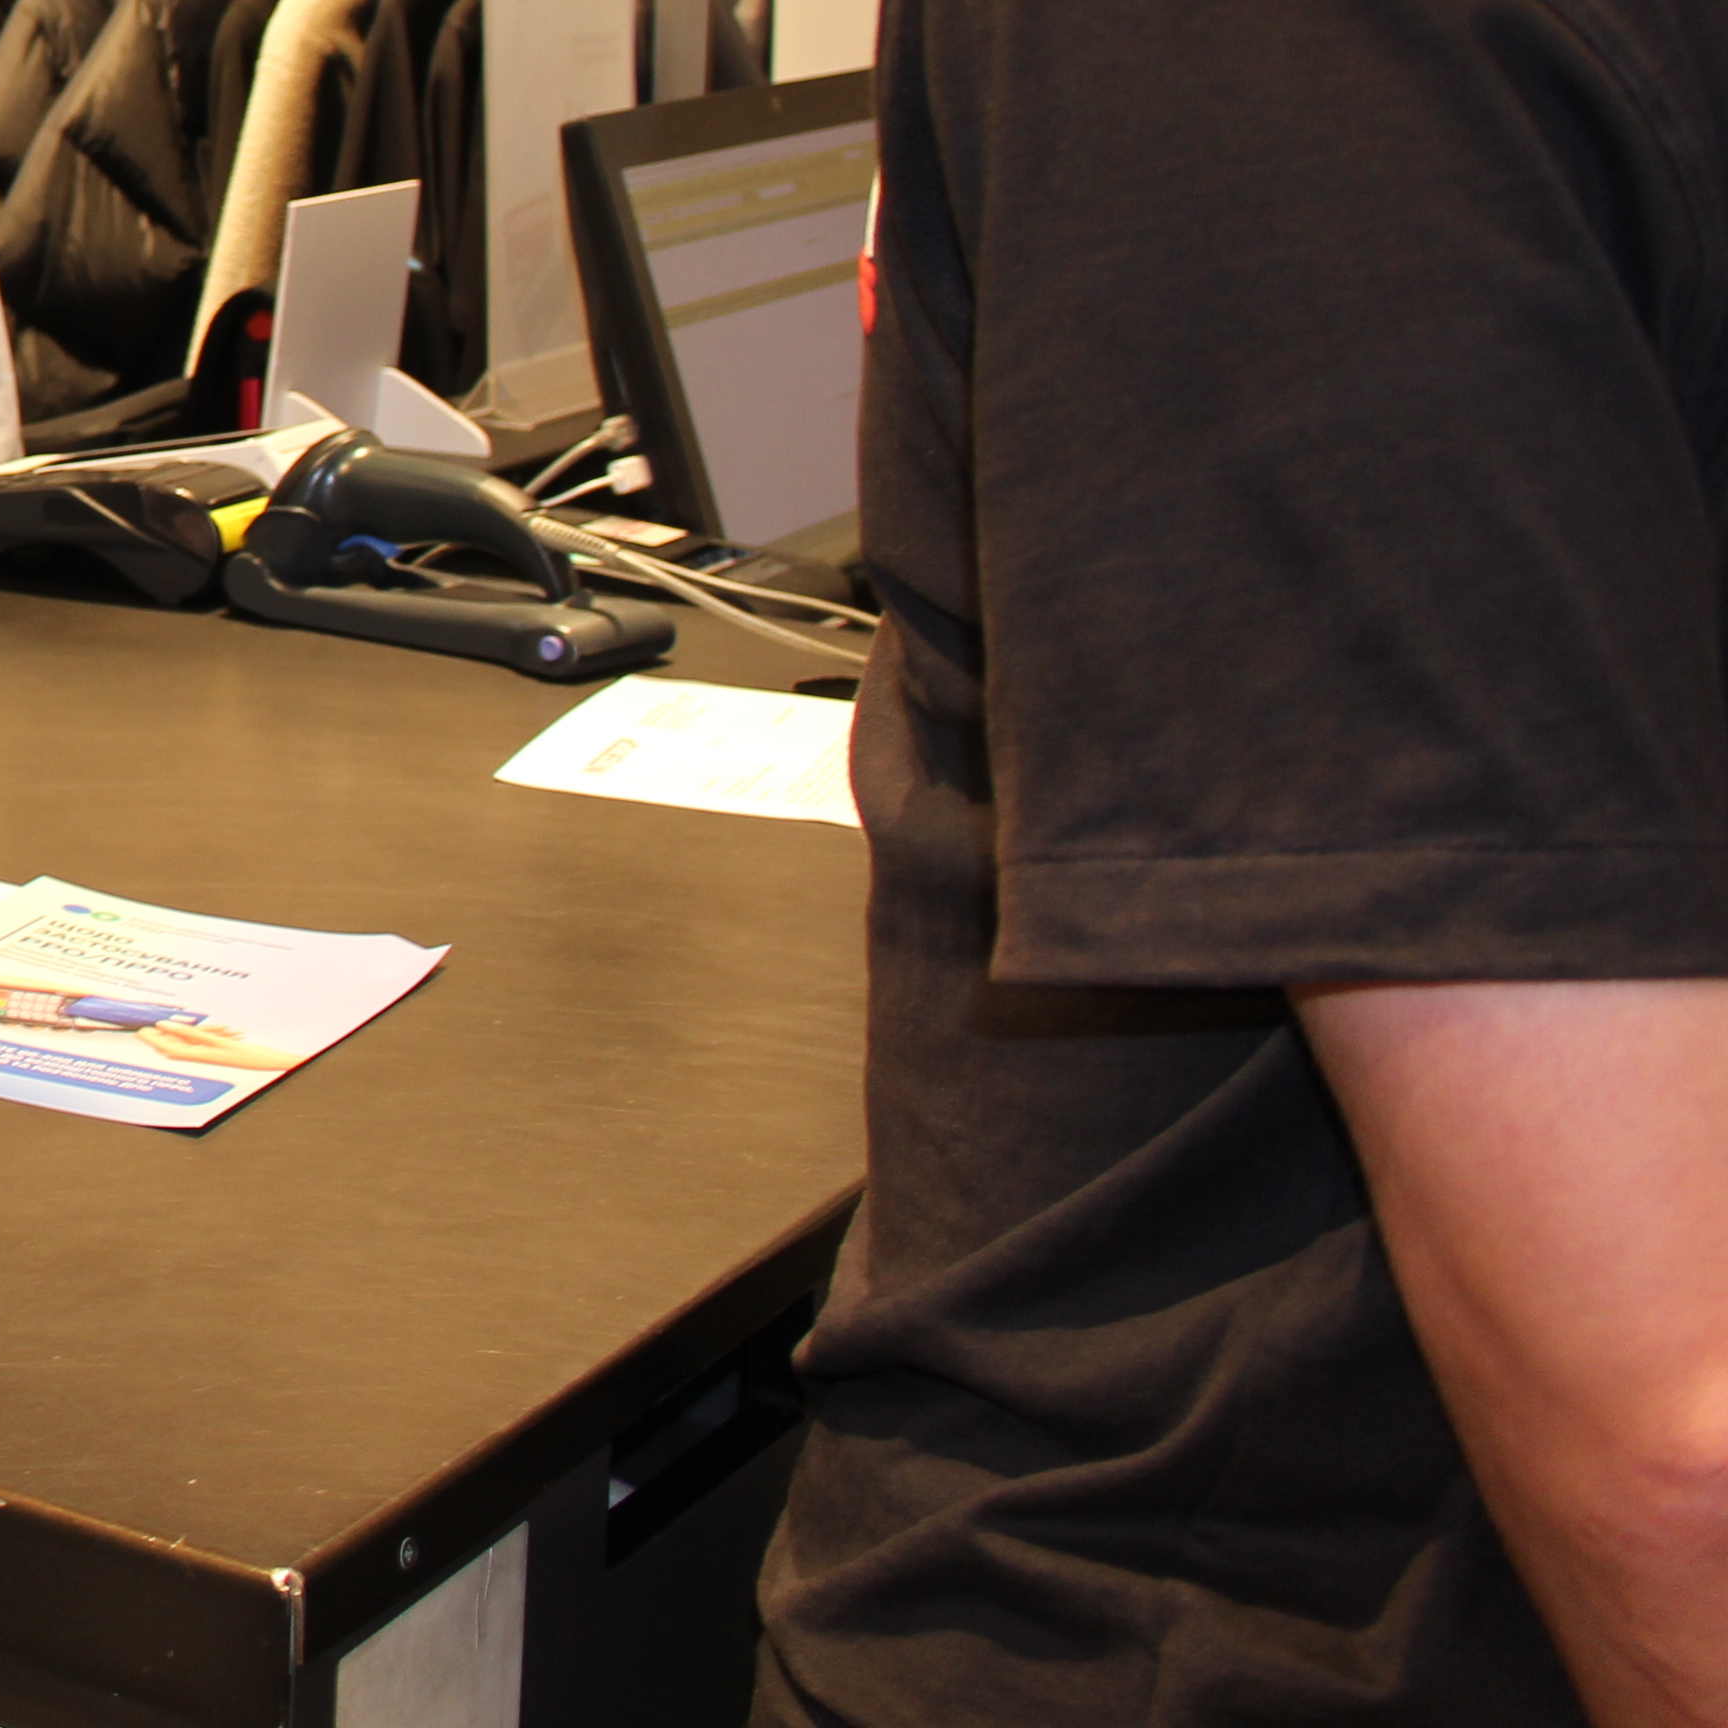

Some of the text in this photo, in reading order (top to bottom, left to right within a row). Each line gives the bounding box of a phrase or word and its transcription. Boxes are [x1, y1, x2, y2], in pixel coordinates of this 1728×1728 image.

[31, 927, 251, 980] ЗАСТОСУВАННЯ
[48, 919, 135, 946] ЩОДО
[19, 934, 195, 982] РРО/ПРРО
